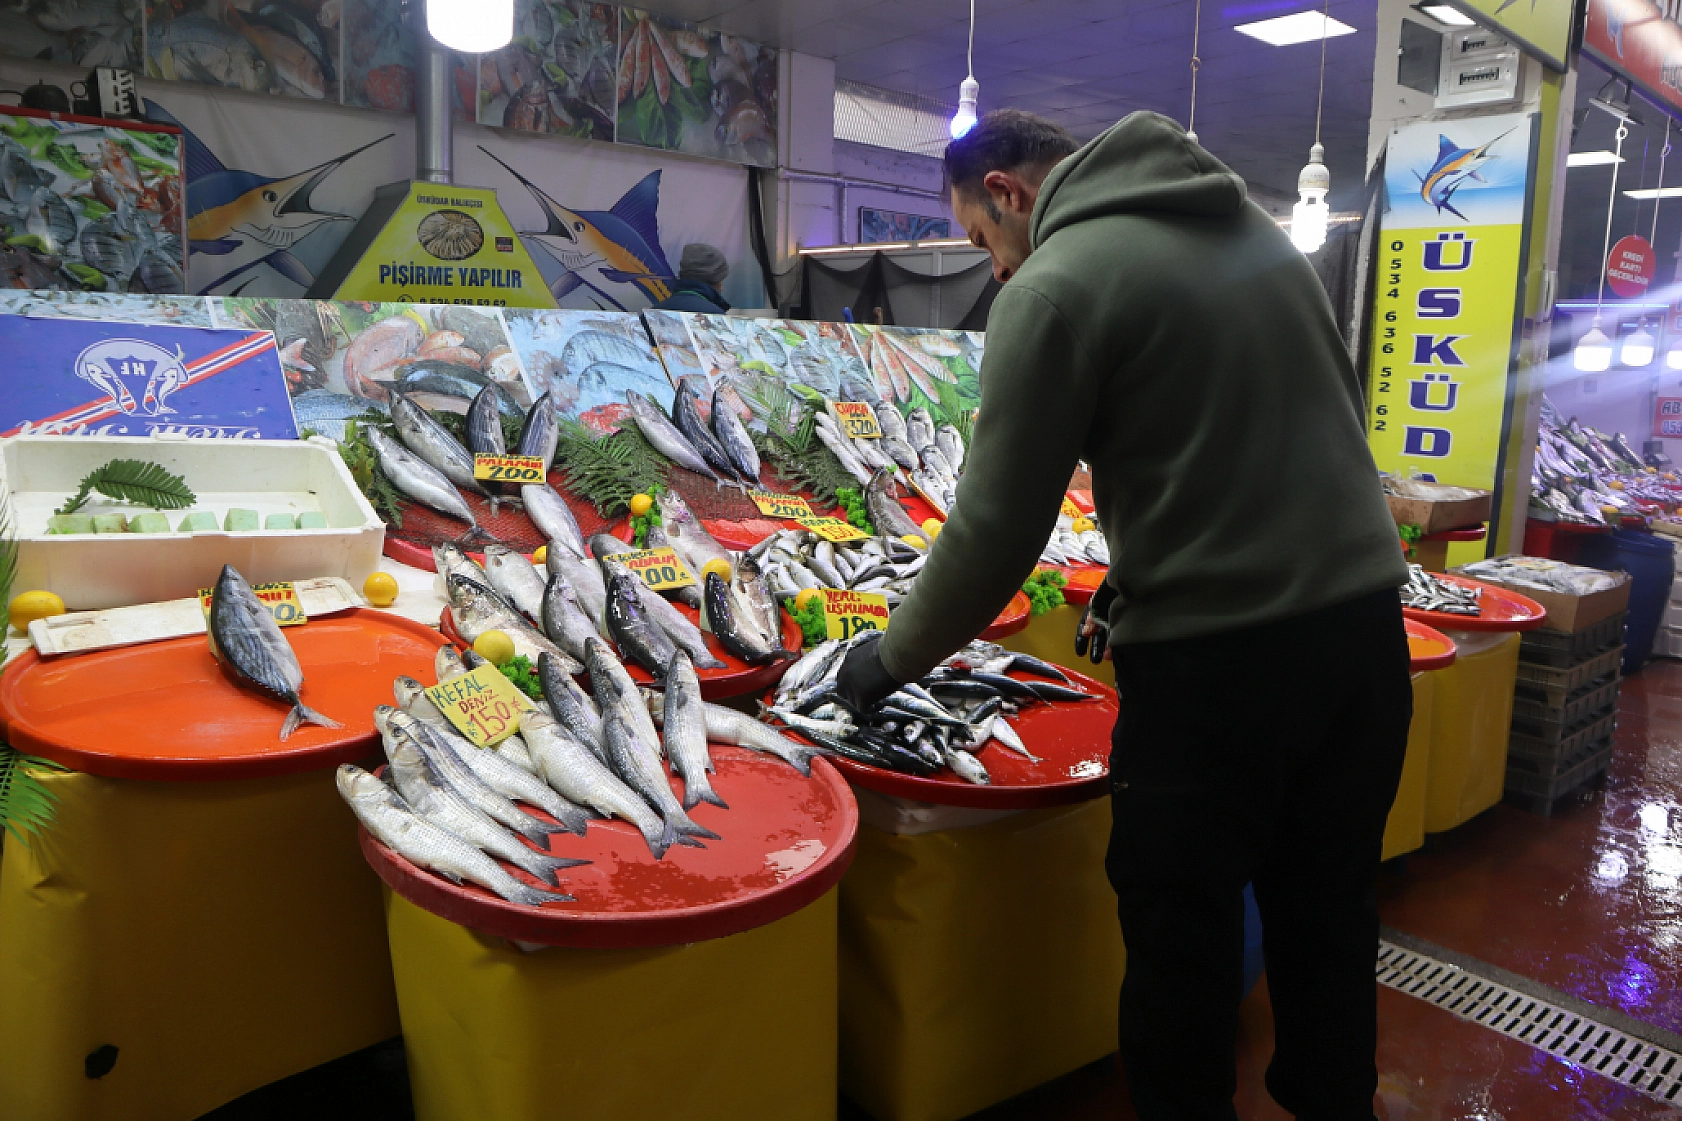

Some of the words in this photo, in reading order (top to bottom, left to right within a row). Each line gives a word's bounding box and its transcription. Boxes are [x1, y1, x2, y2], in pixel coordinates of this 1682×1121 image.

[379, 261, 454, 287] PİŞİRME
[458, 267, 522, 288] YAPILIR
[1399, 232, 1479, 484] ÜSKÜD
[431, 674, 489, 708] KEFAL
